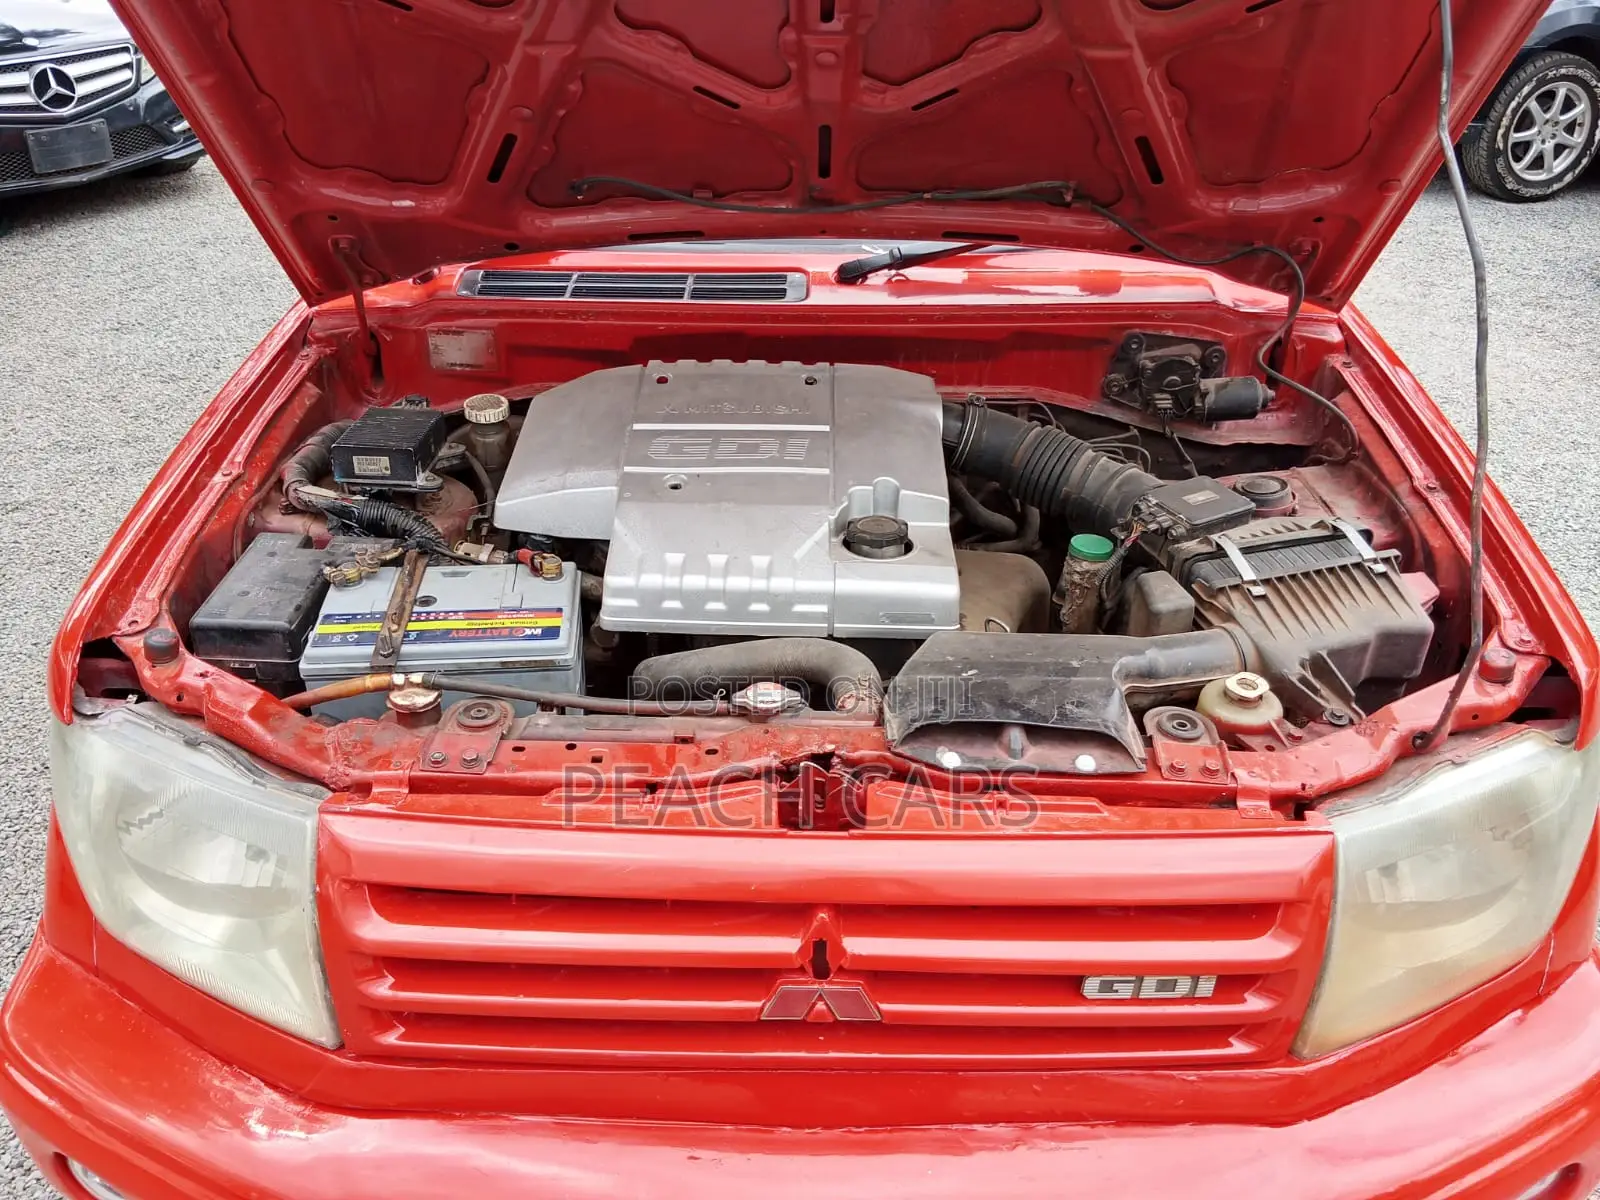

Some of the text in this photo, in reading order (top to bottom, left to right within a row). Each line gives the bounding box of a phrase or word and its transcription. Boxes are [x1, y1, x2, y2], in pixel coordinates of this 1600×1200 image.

[684, 402, 811, 415] MITSUBISHI
[647, 437, 810, 460] GDI
[448, 628, 508, 638] BATTERY
[1081, 975, 1217, 1000] GDI
